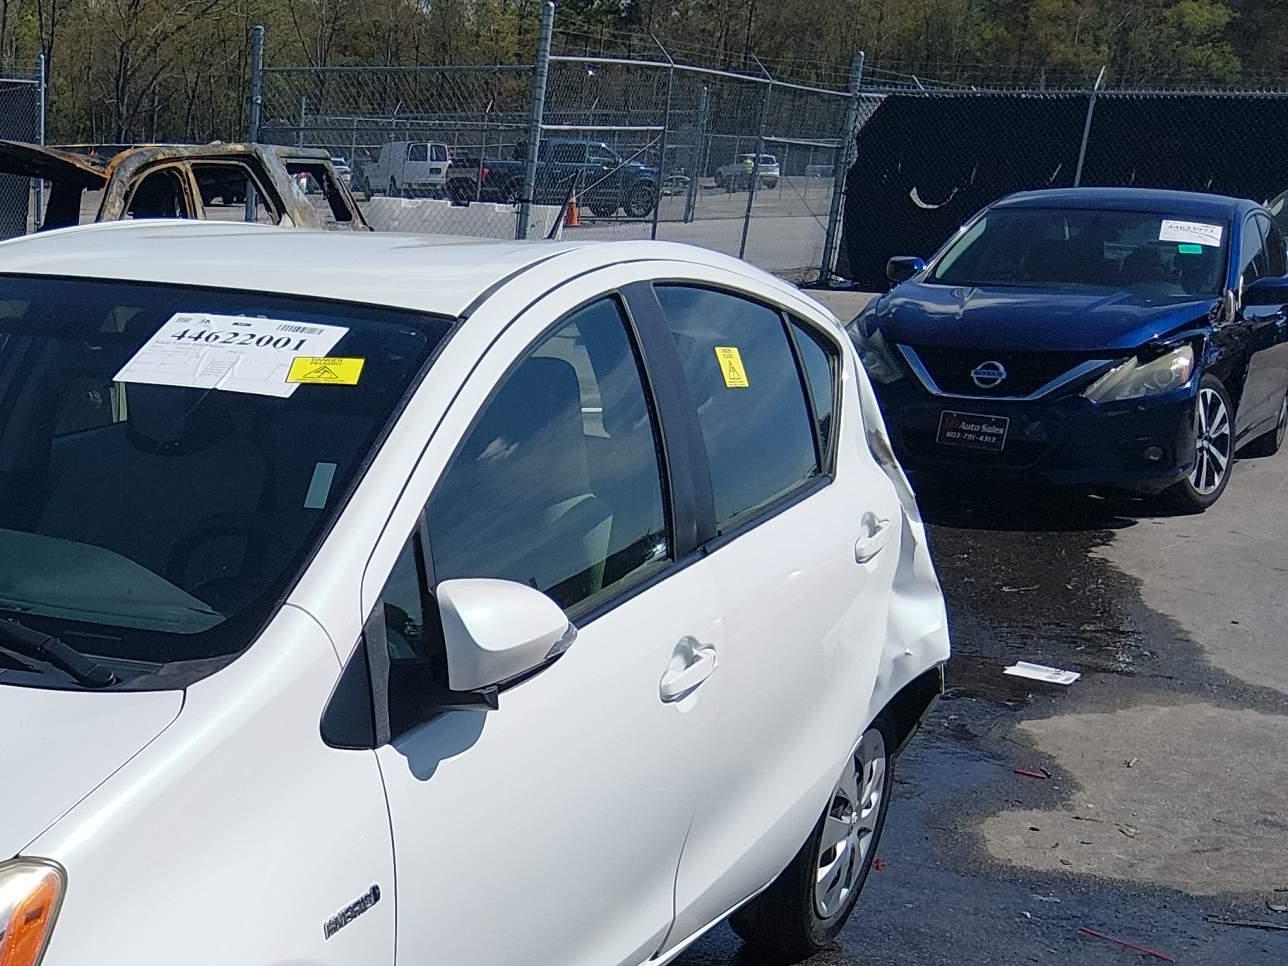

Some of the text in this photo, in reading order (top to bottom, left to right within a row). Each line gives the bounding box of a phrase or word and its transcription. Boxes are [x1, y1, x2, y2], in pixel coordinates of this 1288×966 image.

[170, 328, 308, 351] 44622001
[958, 421, 980, 432] Auto
[980, 423, 1004, 434] Sales
